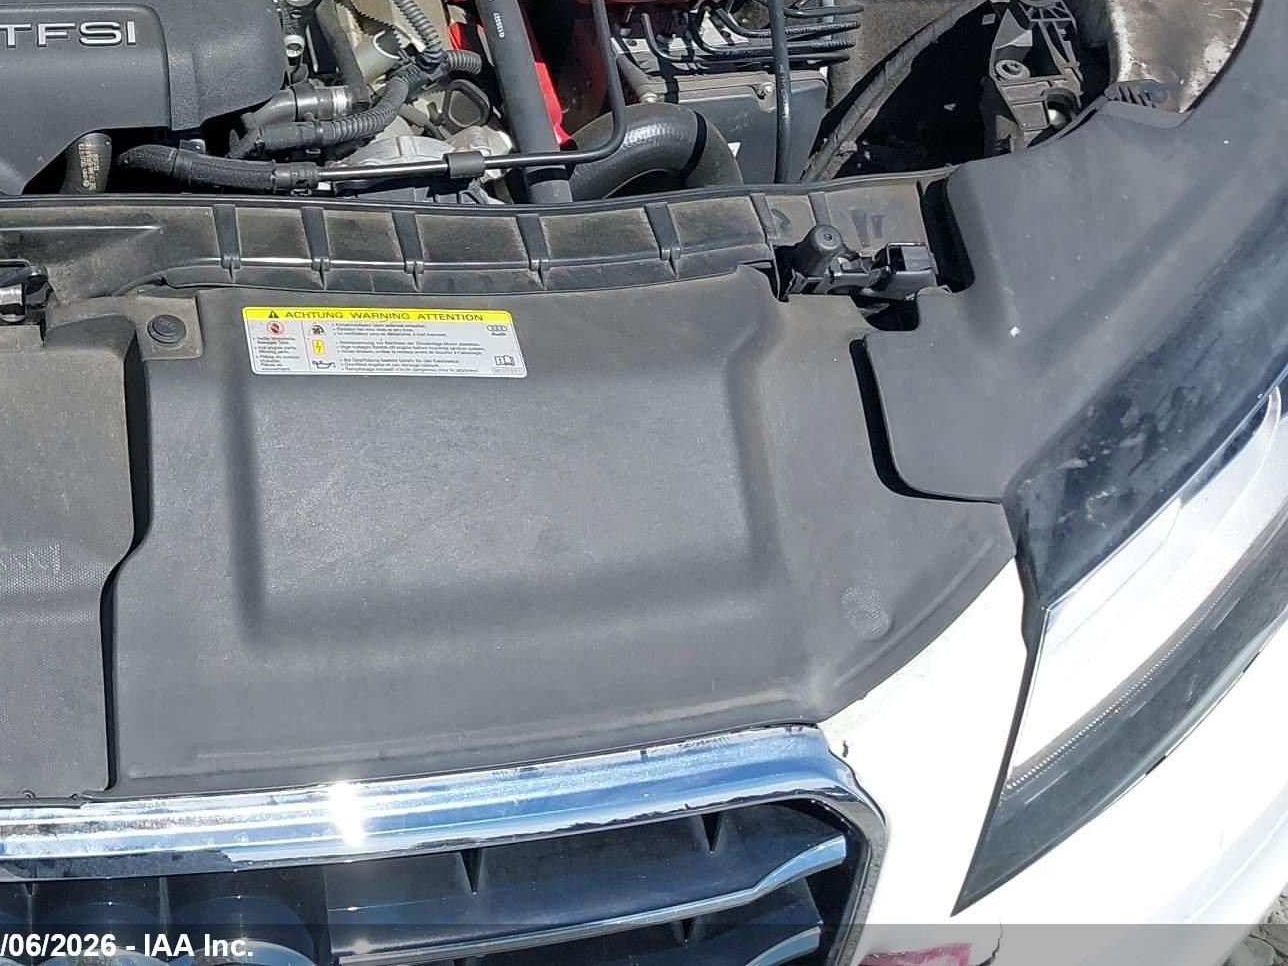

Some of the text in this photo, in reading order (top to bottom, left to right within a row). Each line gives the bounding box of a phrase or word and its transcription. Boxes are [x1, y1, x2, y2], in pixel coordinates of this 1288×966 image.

[285, 311, 483, 321] ACHTUNG WARNING ATTENTION
